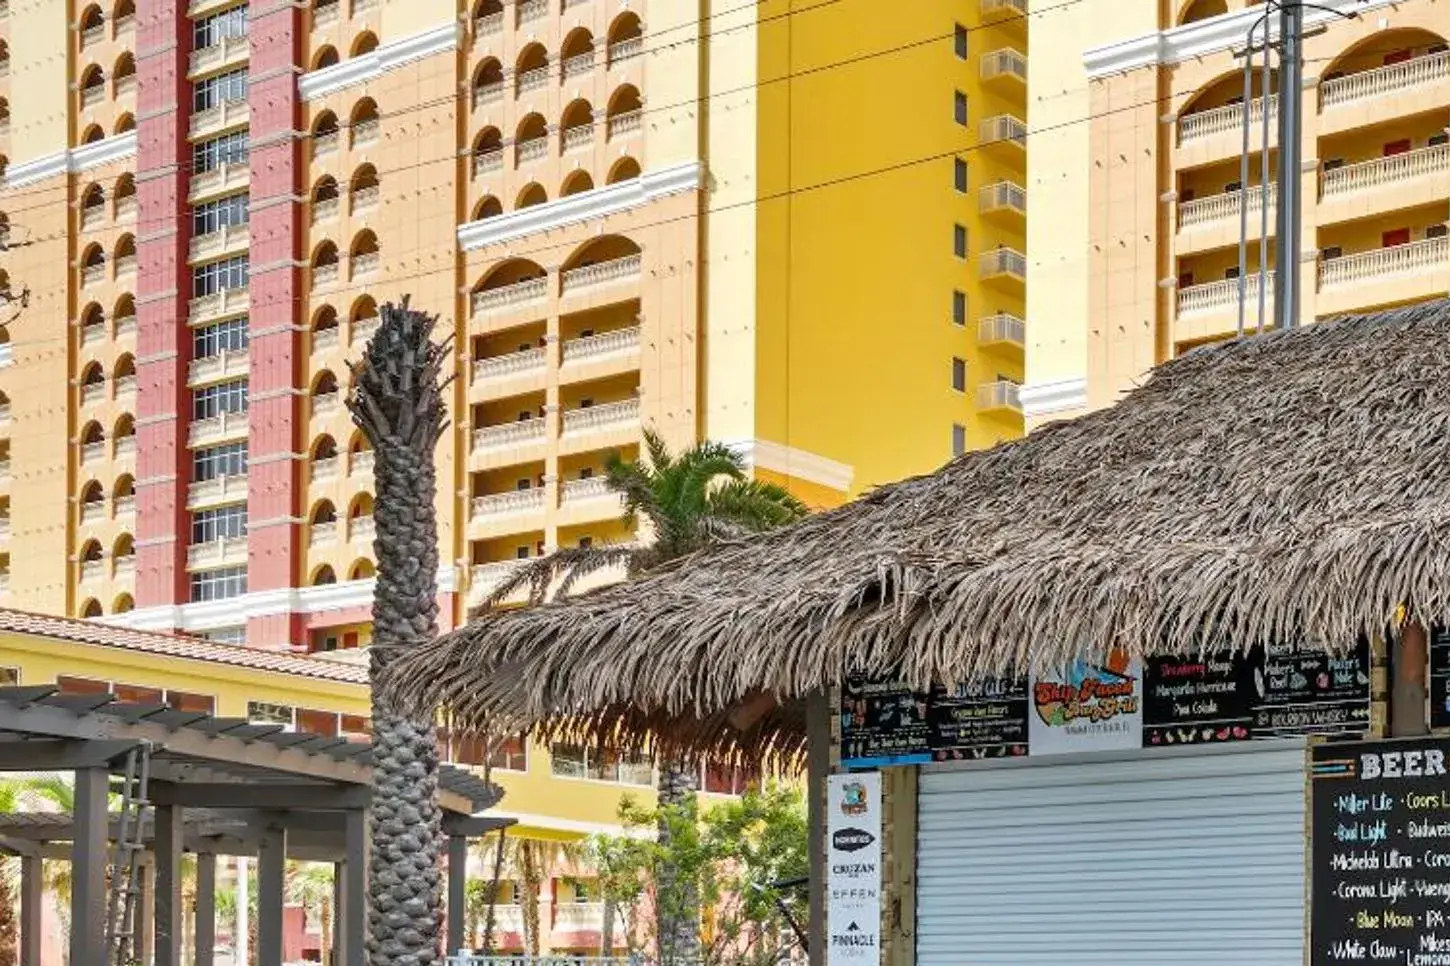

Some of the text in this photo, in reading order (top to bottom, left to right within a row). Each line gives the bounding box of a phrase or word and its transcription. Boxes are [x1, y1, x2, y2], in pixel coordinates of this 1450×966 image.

[1360, 749, 1447, 780] BEER
[1372, 792, 1393, 811] Lite
[1406, 792, 1440, 809] Coors
[1360, 820, 1387, 847] Light
[833, 889, 876, 899] EFFEN
[1338, 883, 1377, 899] Corona
[1379, 880, 1407, 904] Light
[1356, 911, 1380, 929] Blue
[1383, 909, 1414, 928] Moon
[1331, 939, 1397, 959] White Claw
